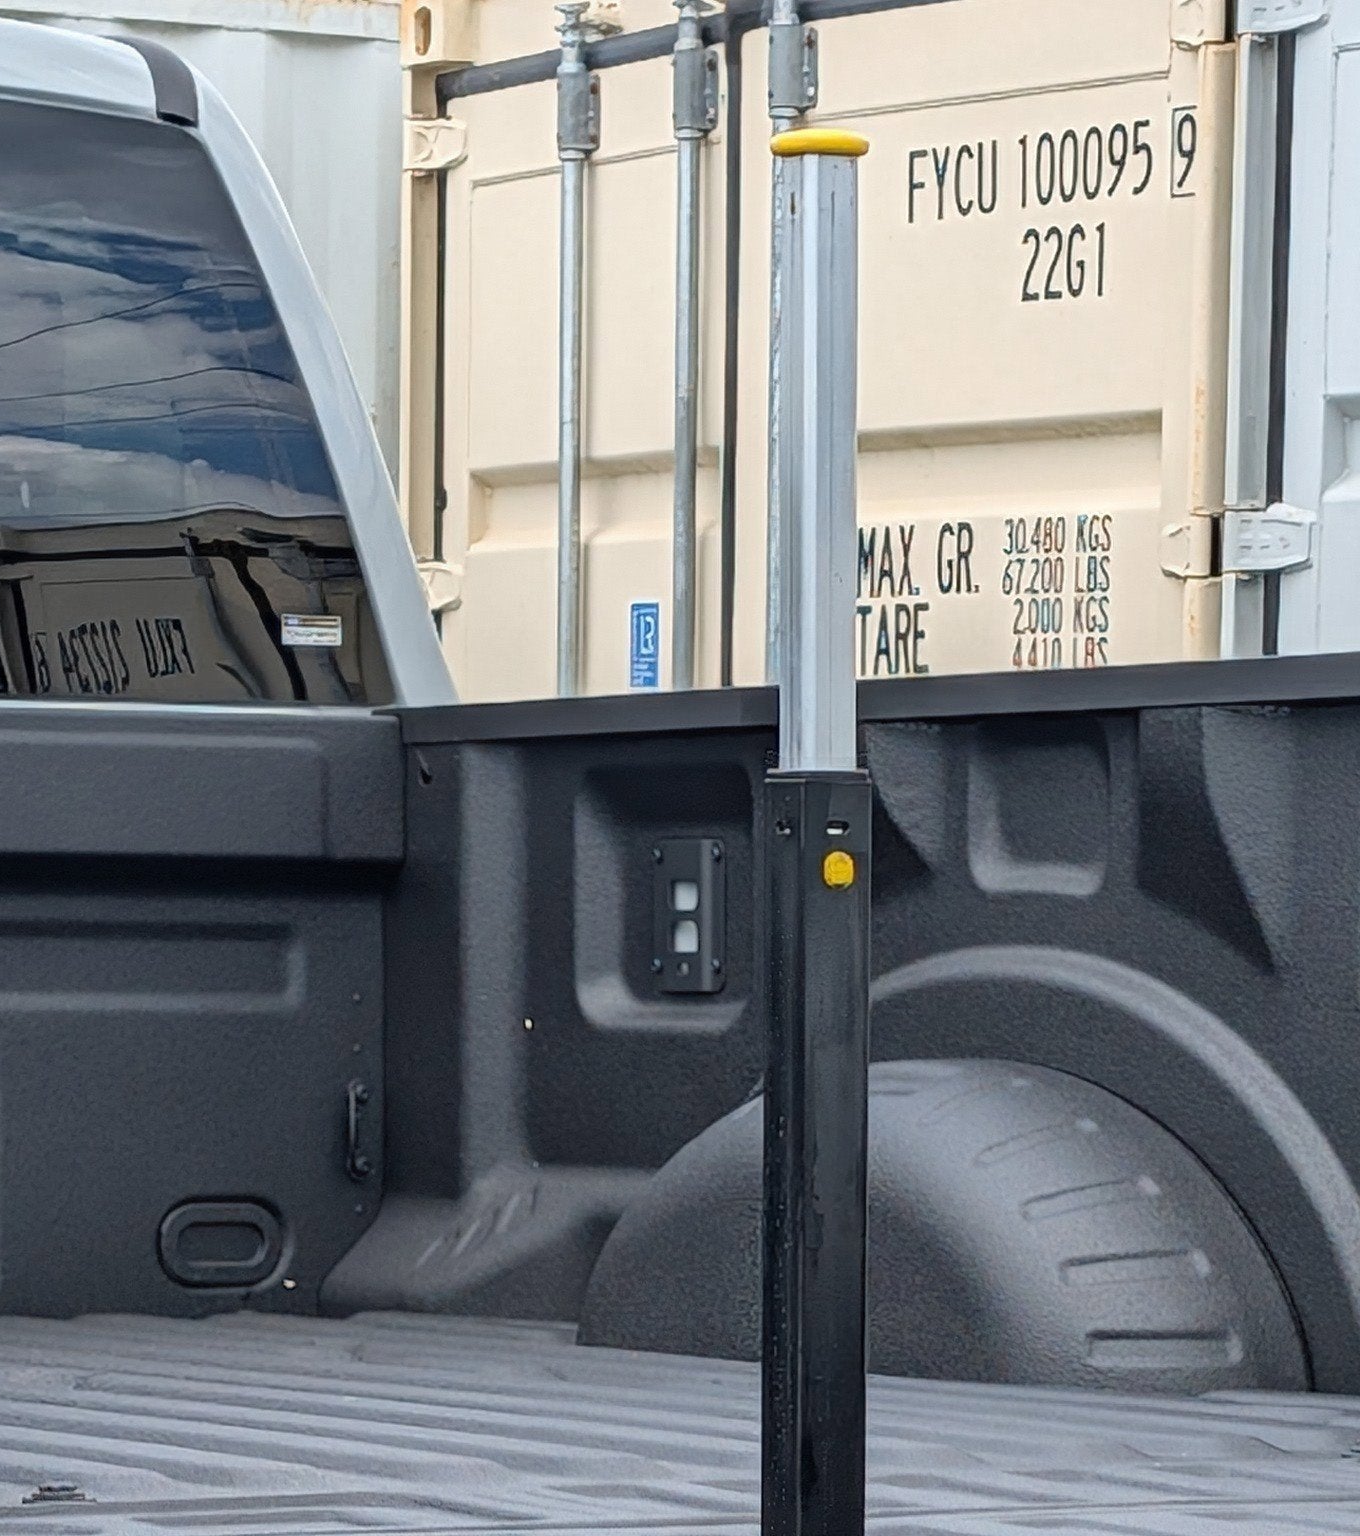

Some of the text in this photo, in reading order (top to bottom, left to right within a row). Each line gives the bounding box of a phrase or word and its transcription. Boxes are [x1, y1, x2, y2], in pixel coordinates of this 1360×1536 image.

[908, 113, 1197, 223] FYCU 100095 9
[1021, 221, 1105, 302] 22G1
[937, 521, 980, 595] GR.
[1076, 514, 1112, 552] KGS
[1075, 555, 1111, 593] LBS
[856, 602, 930, 676] TARE
[1073, 596, 1110, 633] KGS
